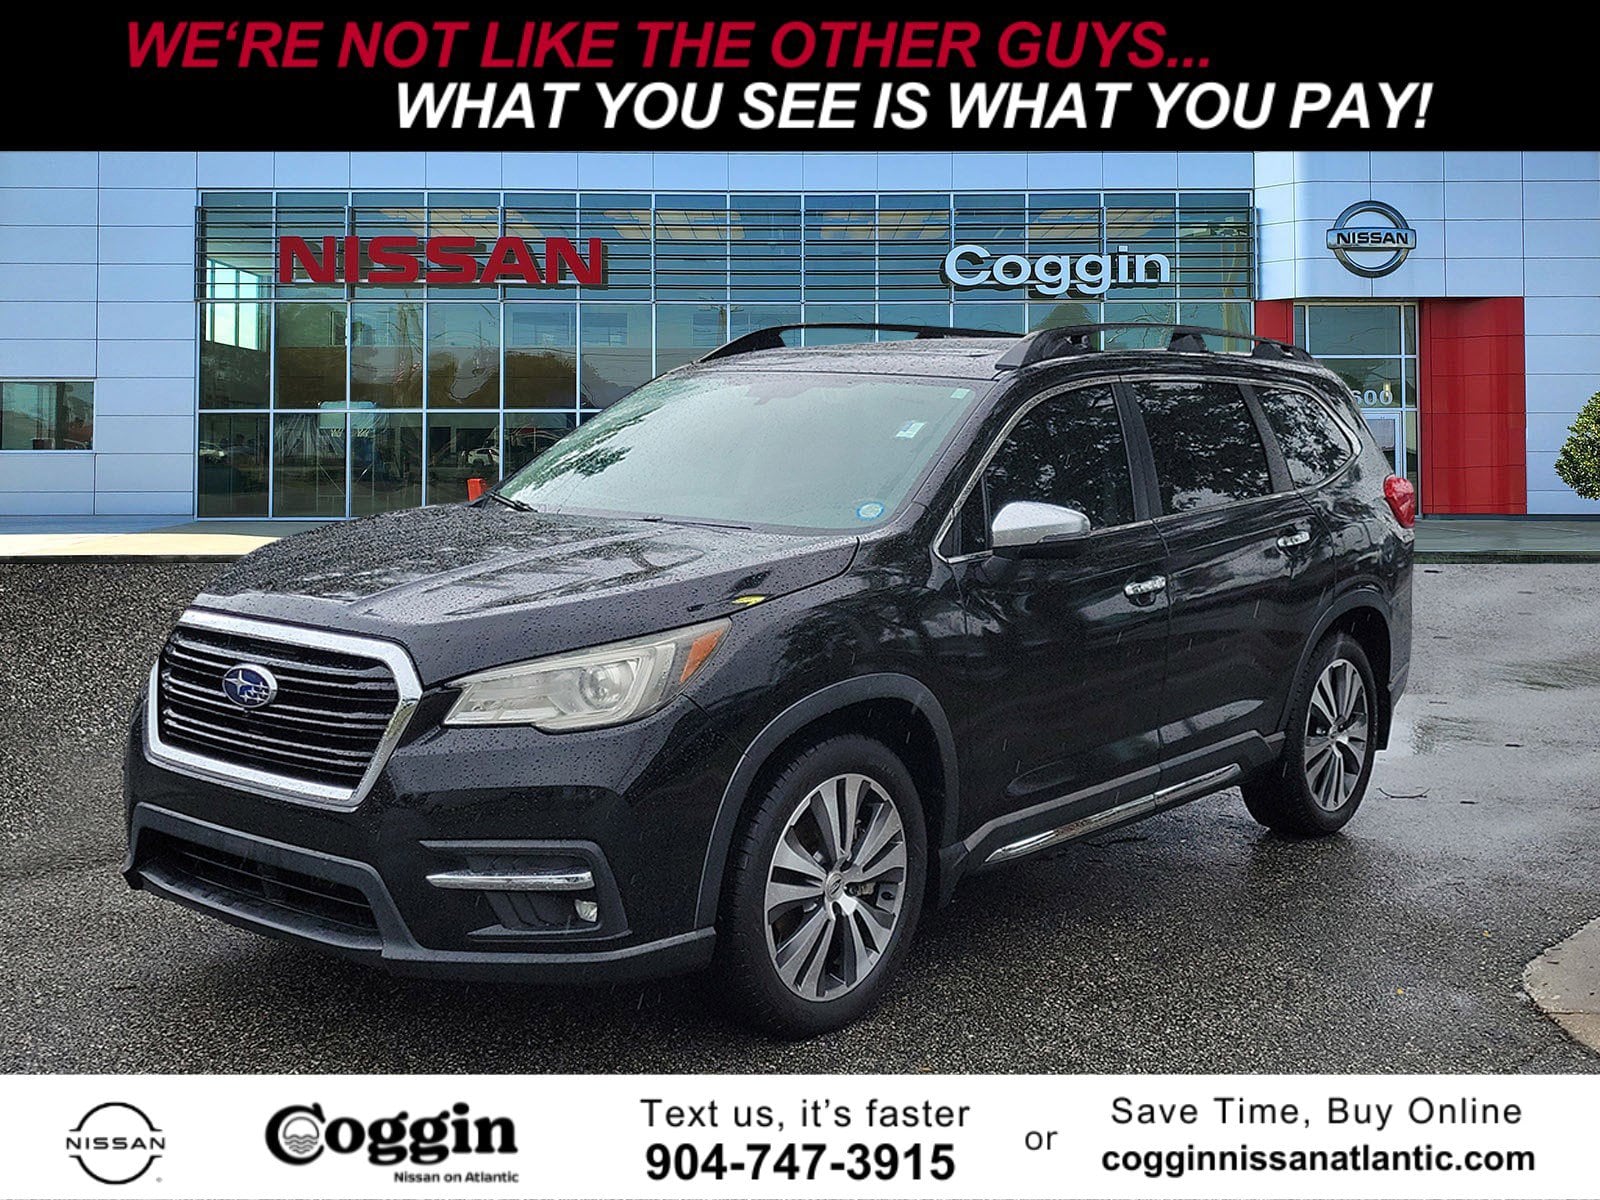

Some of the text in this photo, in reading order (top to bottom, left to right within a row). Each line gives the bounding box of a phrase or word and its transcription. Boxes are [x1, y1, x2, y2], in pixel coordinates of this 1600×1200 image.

[279, 235, 603, 285] NISSAN
[1336, 231, 1409, 246] NISSAN
[944, 244, 1171, 296] Coggin
